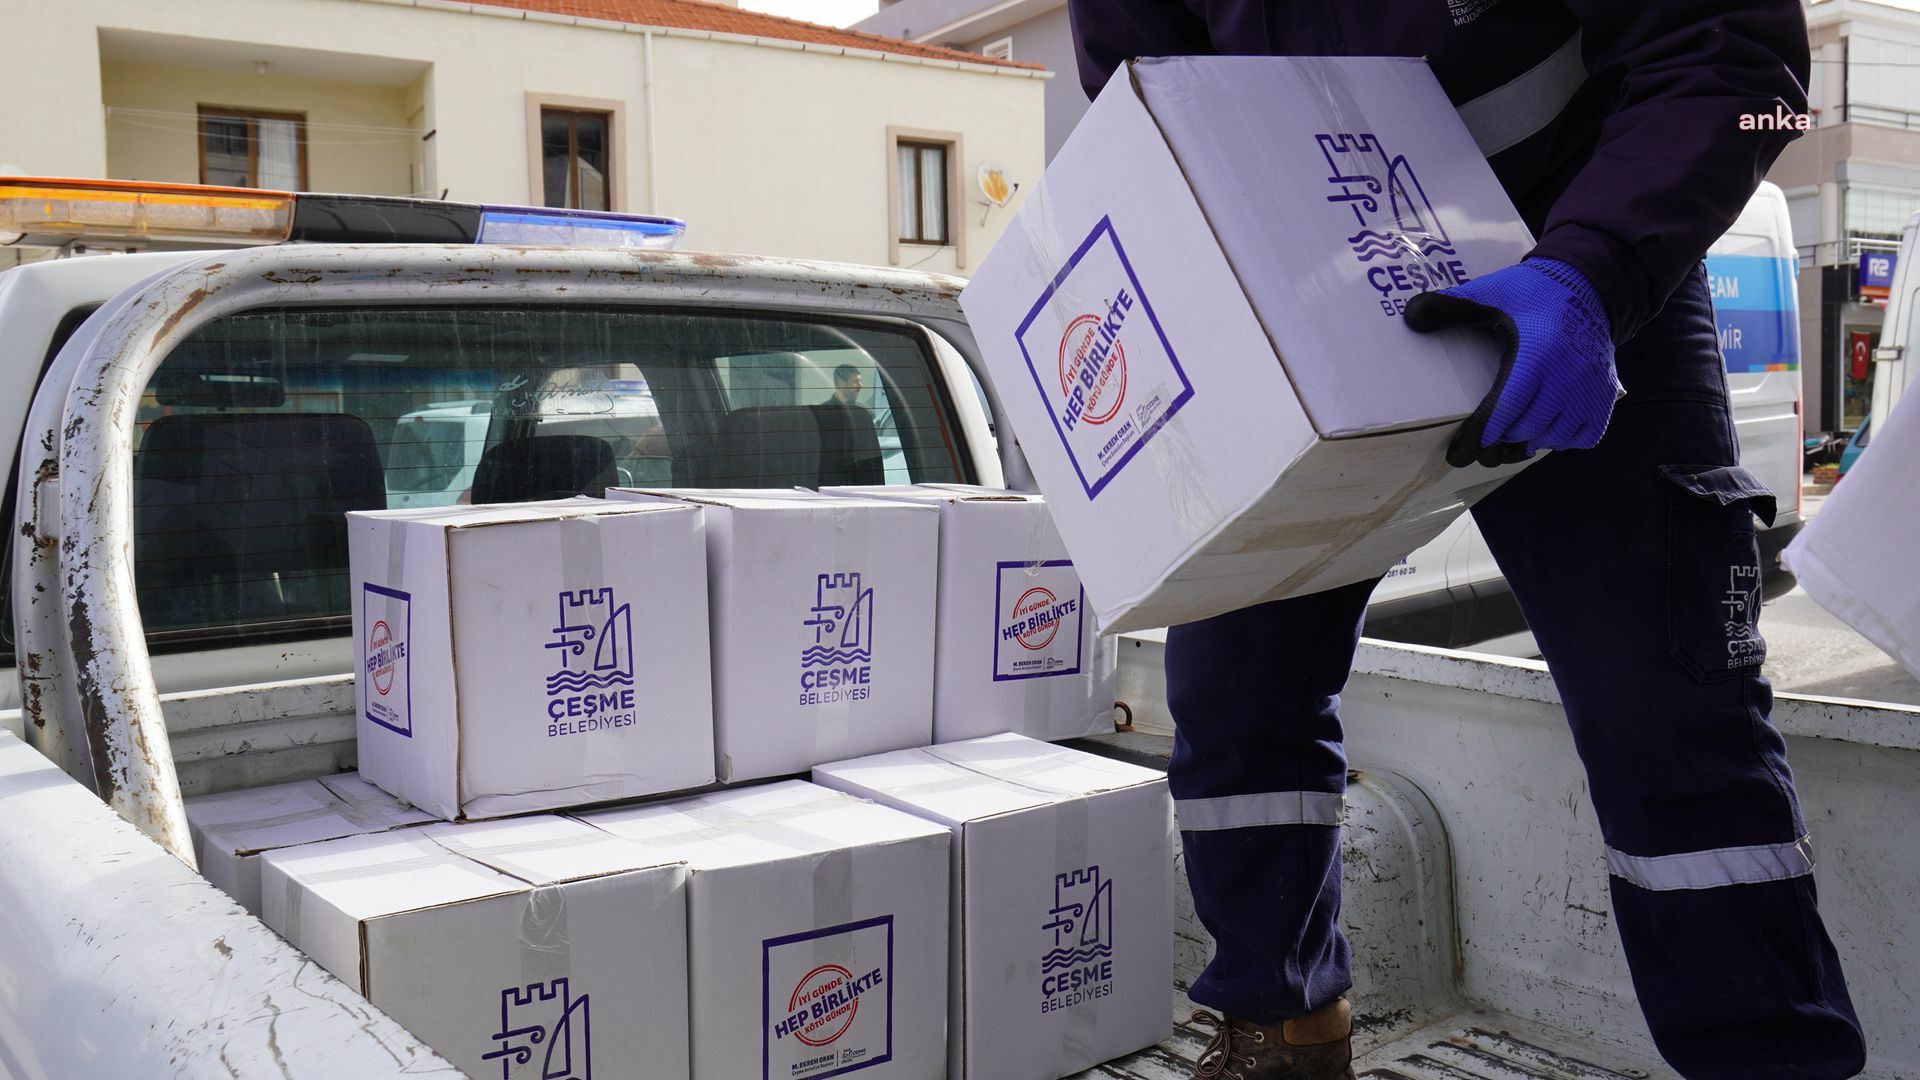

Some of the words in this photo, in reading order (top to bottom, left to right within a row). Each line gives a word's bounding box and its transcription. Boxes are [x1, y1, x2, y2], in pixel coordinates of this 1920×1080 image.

[1062, 385, 1085, 432] HEP
[1080, 288, 1133, 391] BİRLİKTE
[1074, 327, 1096, 367] GÜNDE
[1002, 620, 1026, 641] HEP
[1027, 599, 1077, 631] BİRLİKTE
[1028, 598, 1050, 612] GÜNDE
[367, 655, 377, 674] HEP
[377, 641, 406, 668] BİRLİKTE
[800, 666, 871, 693] ÇEŞME
[800, 685, 871, 706] BELEDİYESİ
[548, 689, 635, 723] ÇEŞME
[548, 710, 636, 737] BELEDİYESİ
[798, 991, 811, 1006] İYİ
[812, 976, 843, 999] GÜNDE
[1041, 960, 1113, 999] ÇEŞME
[774, 1009, 809, 1040] HEP
[810, 967, 883, 1019] BİRLİKTE
[1041, 981, 1113, 1014] BELEDİYESİ
[804, 1016, 825, 1035] KÖTÜ
[825, 1003, 852, 1023] GÜNDE
